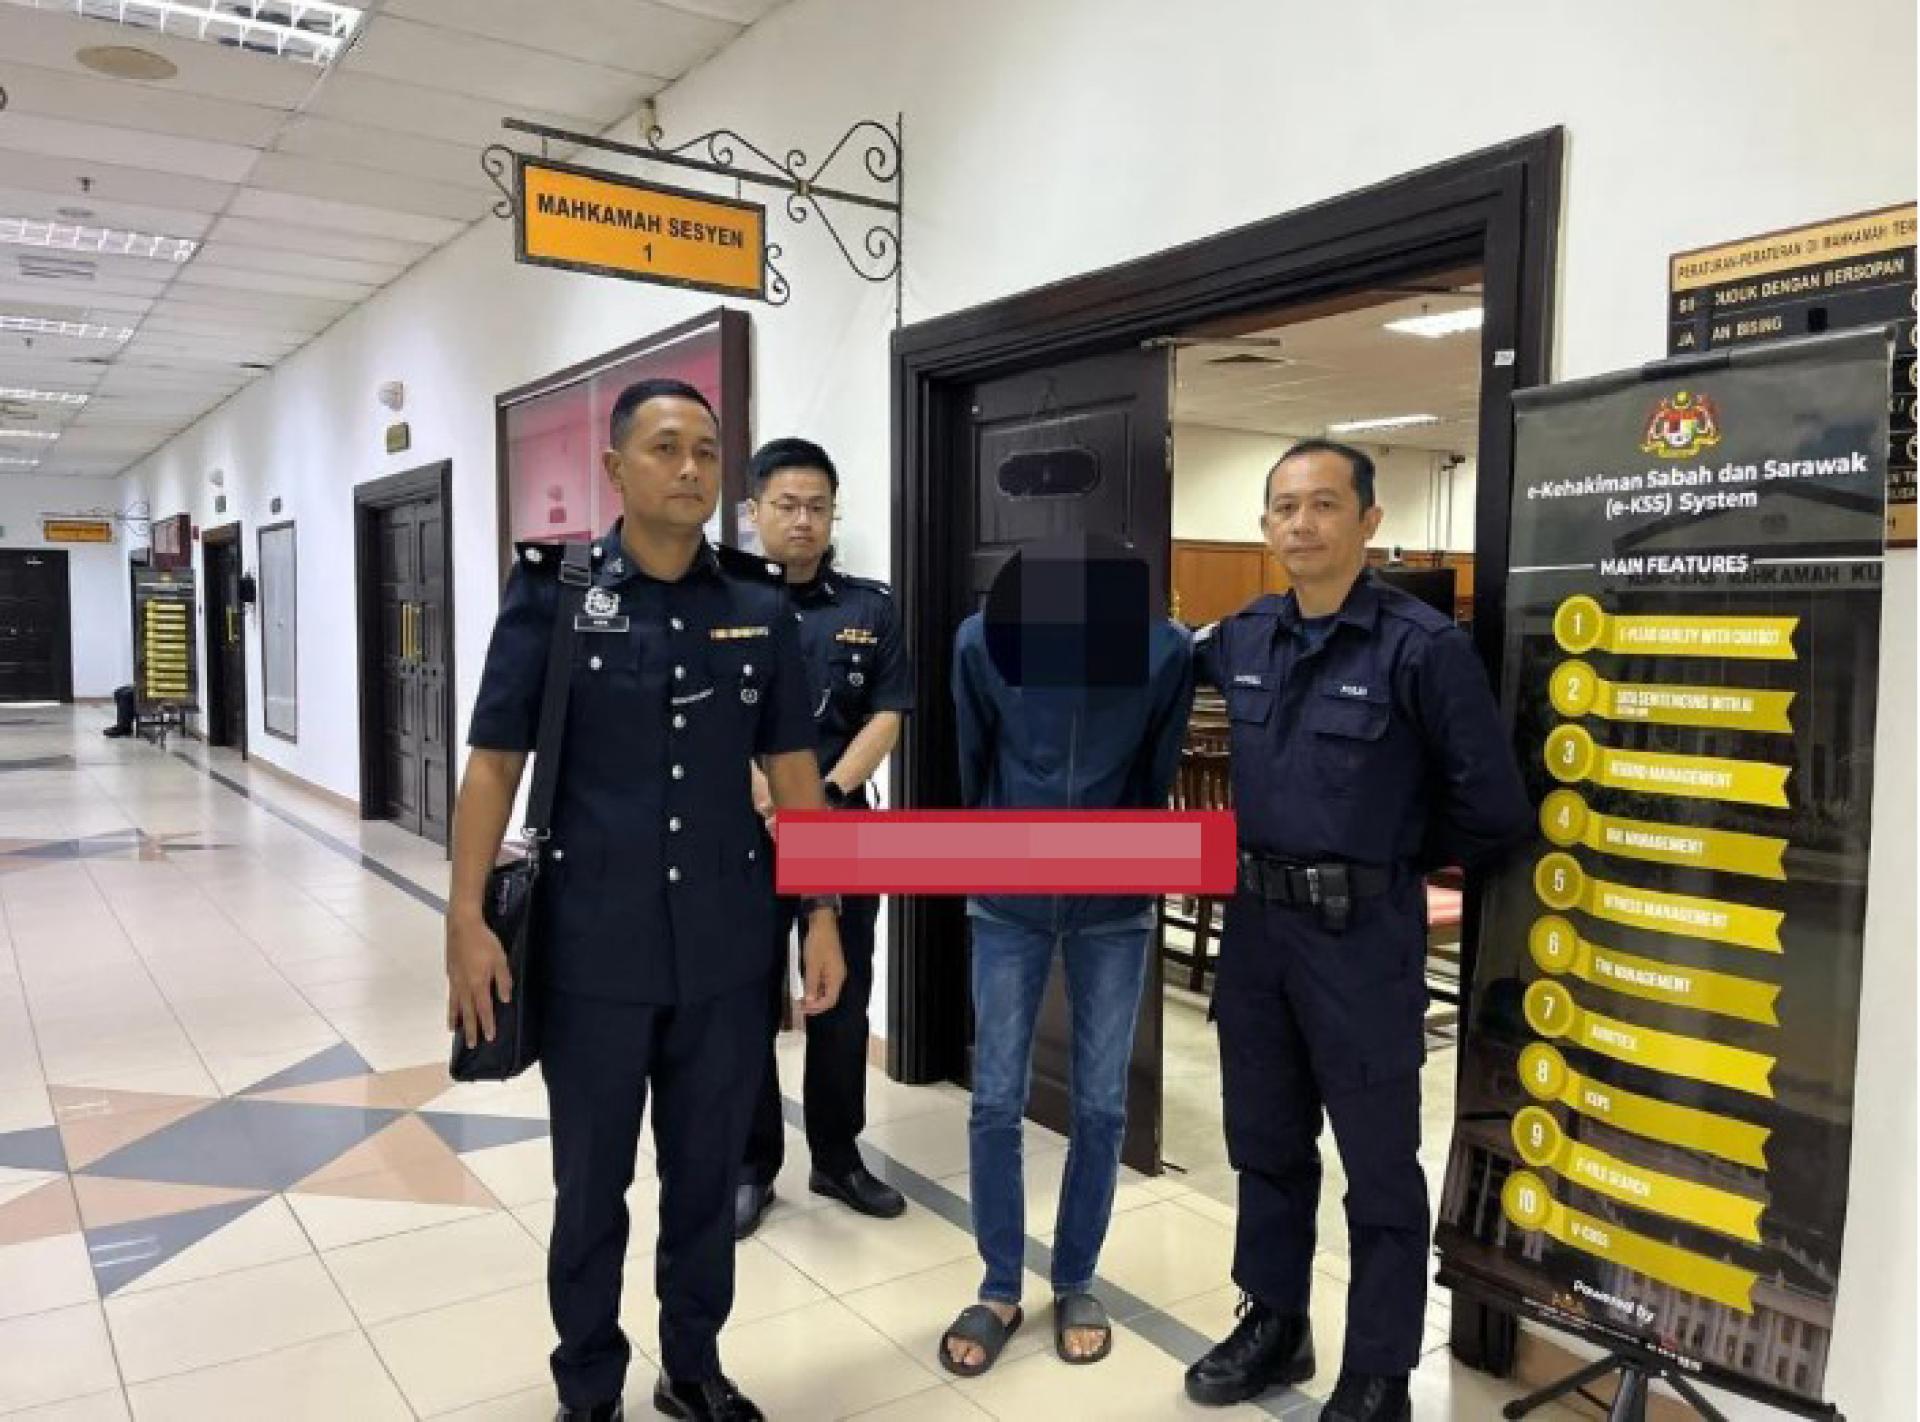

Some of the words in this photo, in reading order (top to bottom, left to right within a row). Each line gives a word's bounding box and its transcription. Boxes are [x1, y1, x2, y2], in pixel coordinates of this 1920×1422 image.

[537, 193, 662, 234] MAHKAMAH
[668, 217, 744, 249] SESYEN
[1823, 225, 1888, 248] MAHKAMAH
[644, 243, 652, 262] 1
[1762, 274, 1820, 298] DENGAN
[1824, 258, 1905, 287] BERSOPAN
[1737, 316, 1782, 337] BISING
[1527, 473, 1643, 499] e-Kehakiman
[1647, 466, 1713, 488] Sabah
[1718, 463, 1758, 483] dan
[1764, 452, 1868, 479] Sarawak
[1606, 493, 1672, 520] (e-KSS)
[1680, 490, 1758, 515] System
[1600, 556, 1642, 575] MAIN
[1647, 553, 1749, 573] FEATURES
[1574, 615, 1581, 636] 1
[1567, 677, 1580, 701] 2
[1562, 740, 1575, 763] 3
[1649, 765, 1733, 788] MANAGEMENT
[1556, 806, 1570, 828] 4
[1553, 869, 1565, 891] 5
[1548, 932, 1560, 955] 6
[1544, 996, 1555, 1020] 7
[1536, 1059, 1549, 1083] 8
[1530, 1124, 1543, 1148] 9
[1519, 1187, 1537, 1213] 10
[1573, 1279, 1635, 1313] Powered
[1636, 1304, 1656, 1326] by
